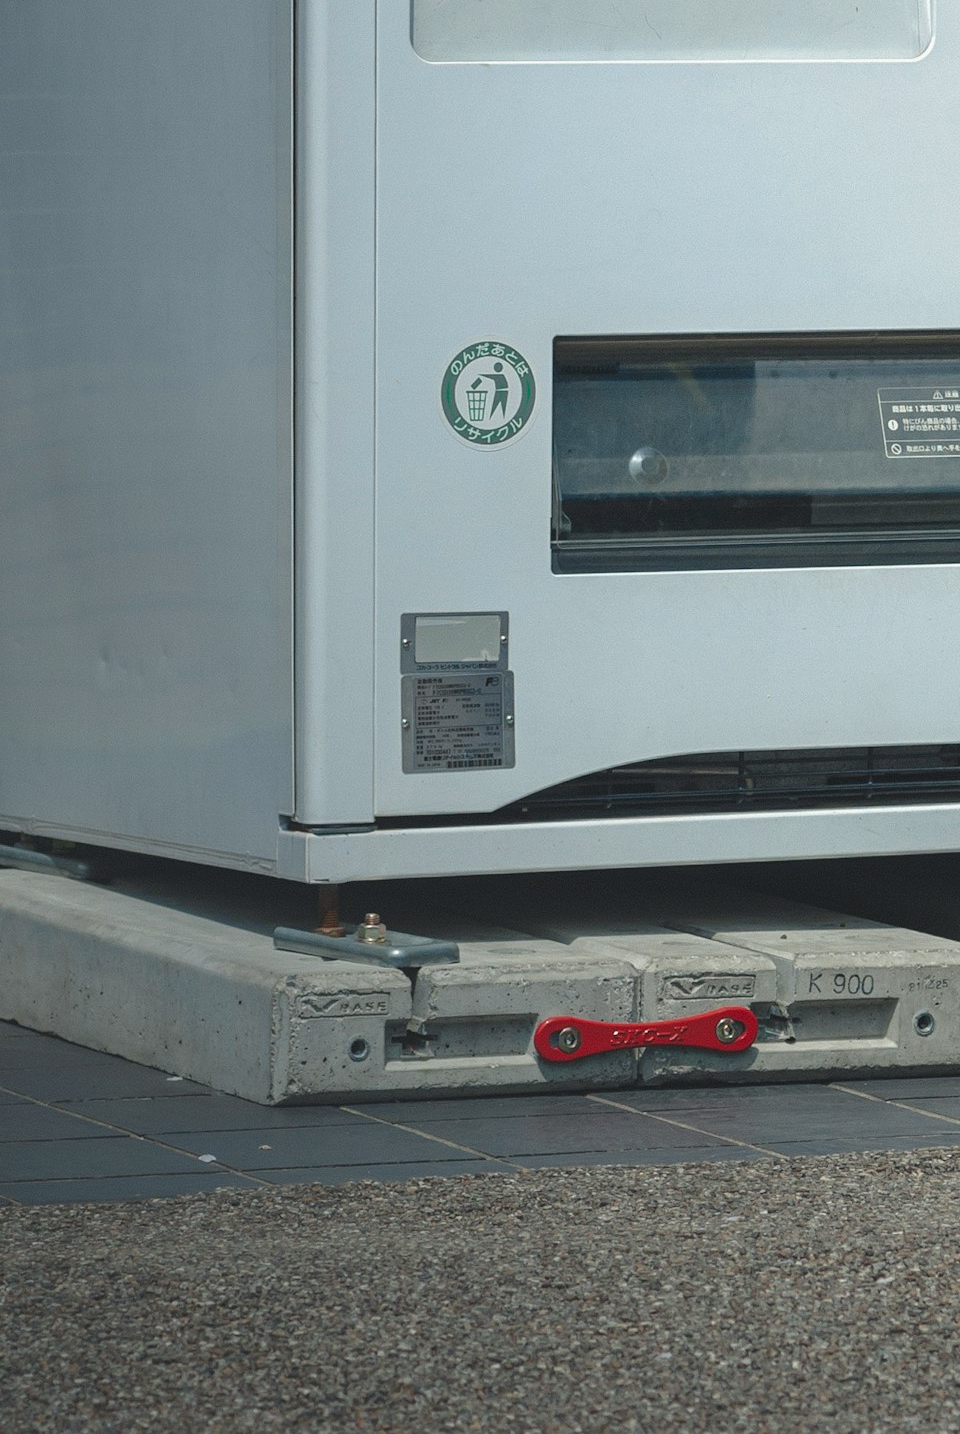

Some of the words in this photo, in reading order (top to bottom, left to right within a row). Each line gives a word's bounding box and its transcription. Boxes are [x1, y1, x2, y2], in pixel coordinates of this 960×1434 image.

[450, 342, 529, 377] のんだあとは
[453, 417, 523, 444] リサイクル
[809, 973, 823, 993] K
[833, 974, 874, 995] 900
